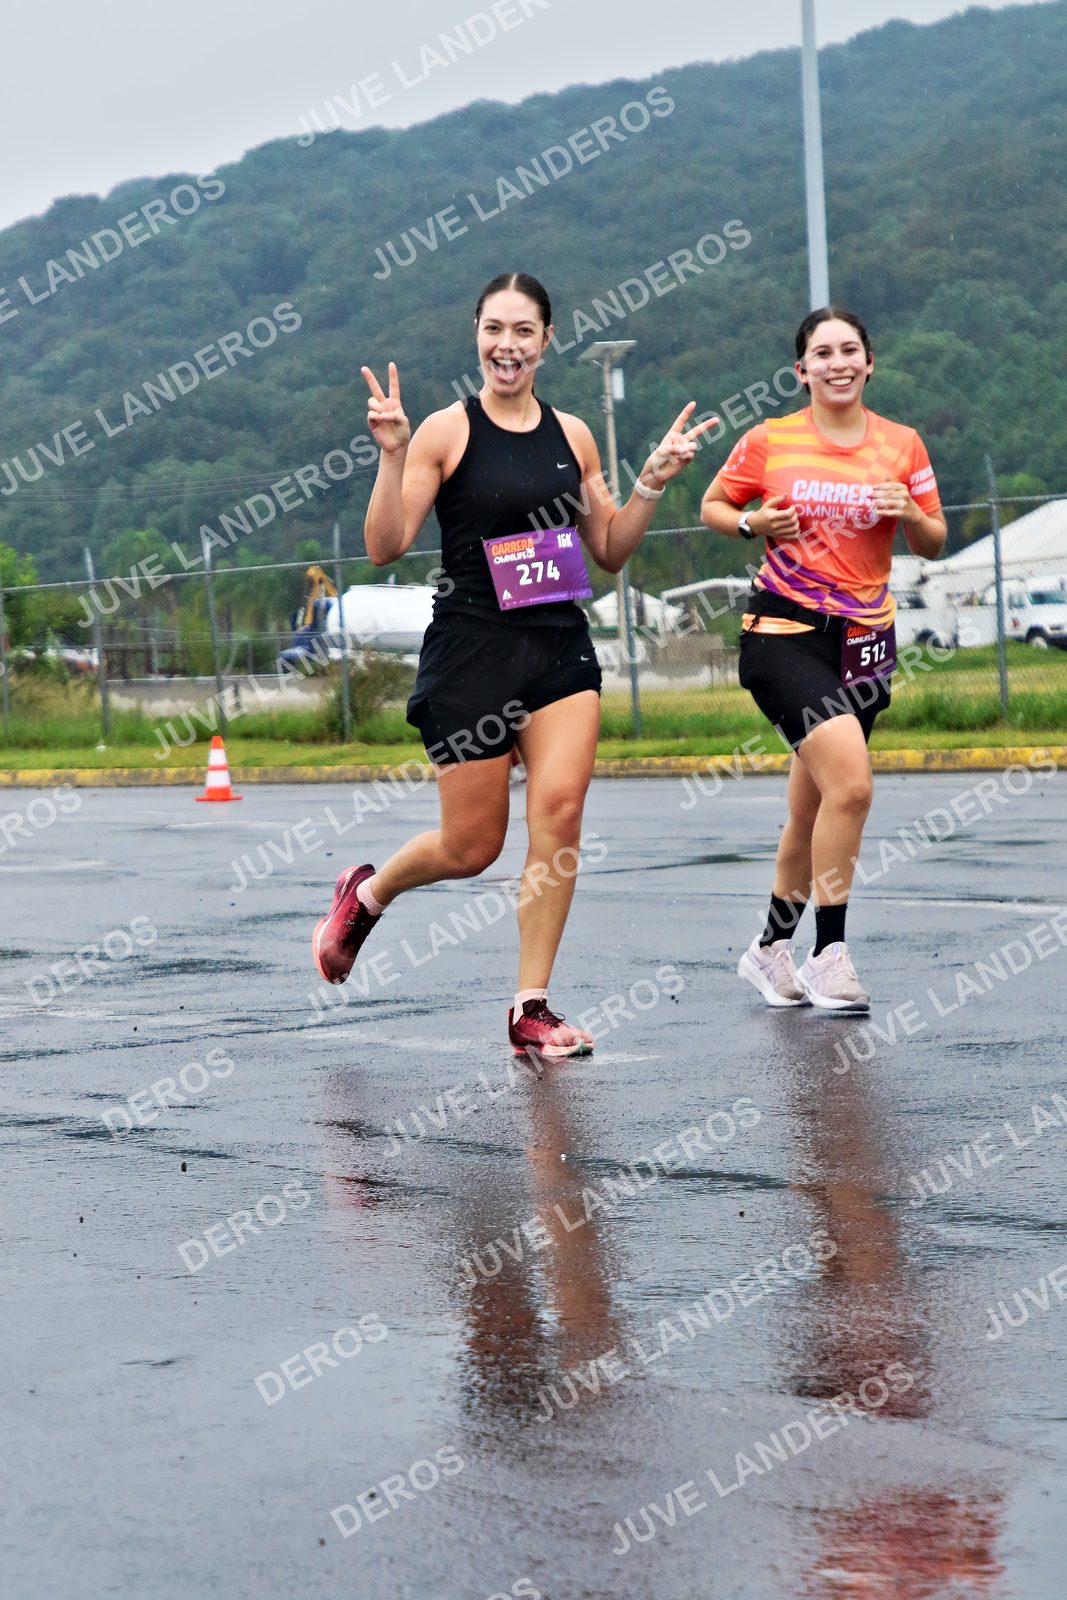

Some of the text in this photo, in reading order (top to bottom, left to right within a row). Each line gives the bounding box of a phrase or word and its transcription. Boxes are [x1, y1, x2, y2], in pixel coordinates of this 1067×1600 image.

[791, 479, 875, 508] CARRER
[795, 503, 863, 520] OMNILIFE
[492, 537, 534, 556] CARRERA
[516, 560, 560, 585] 274
[860, 640, 886, 666] 512
